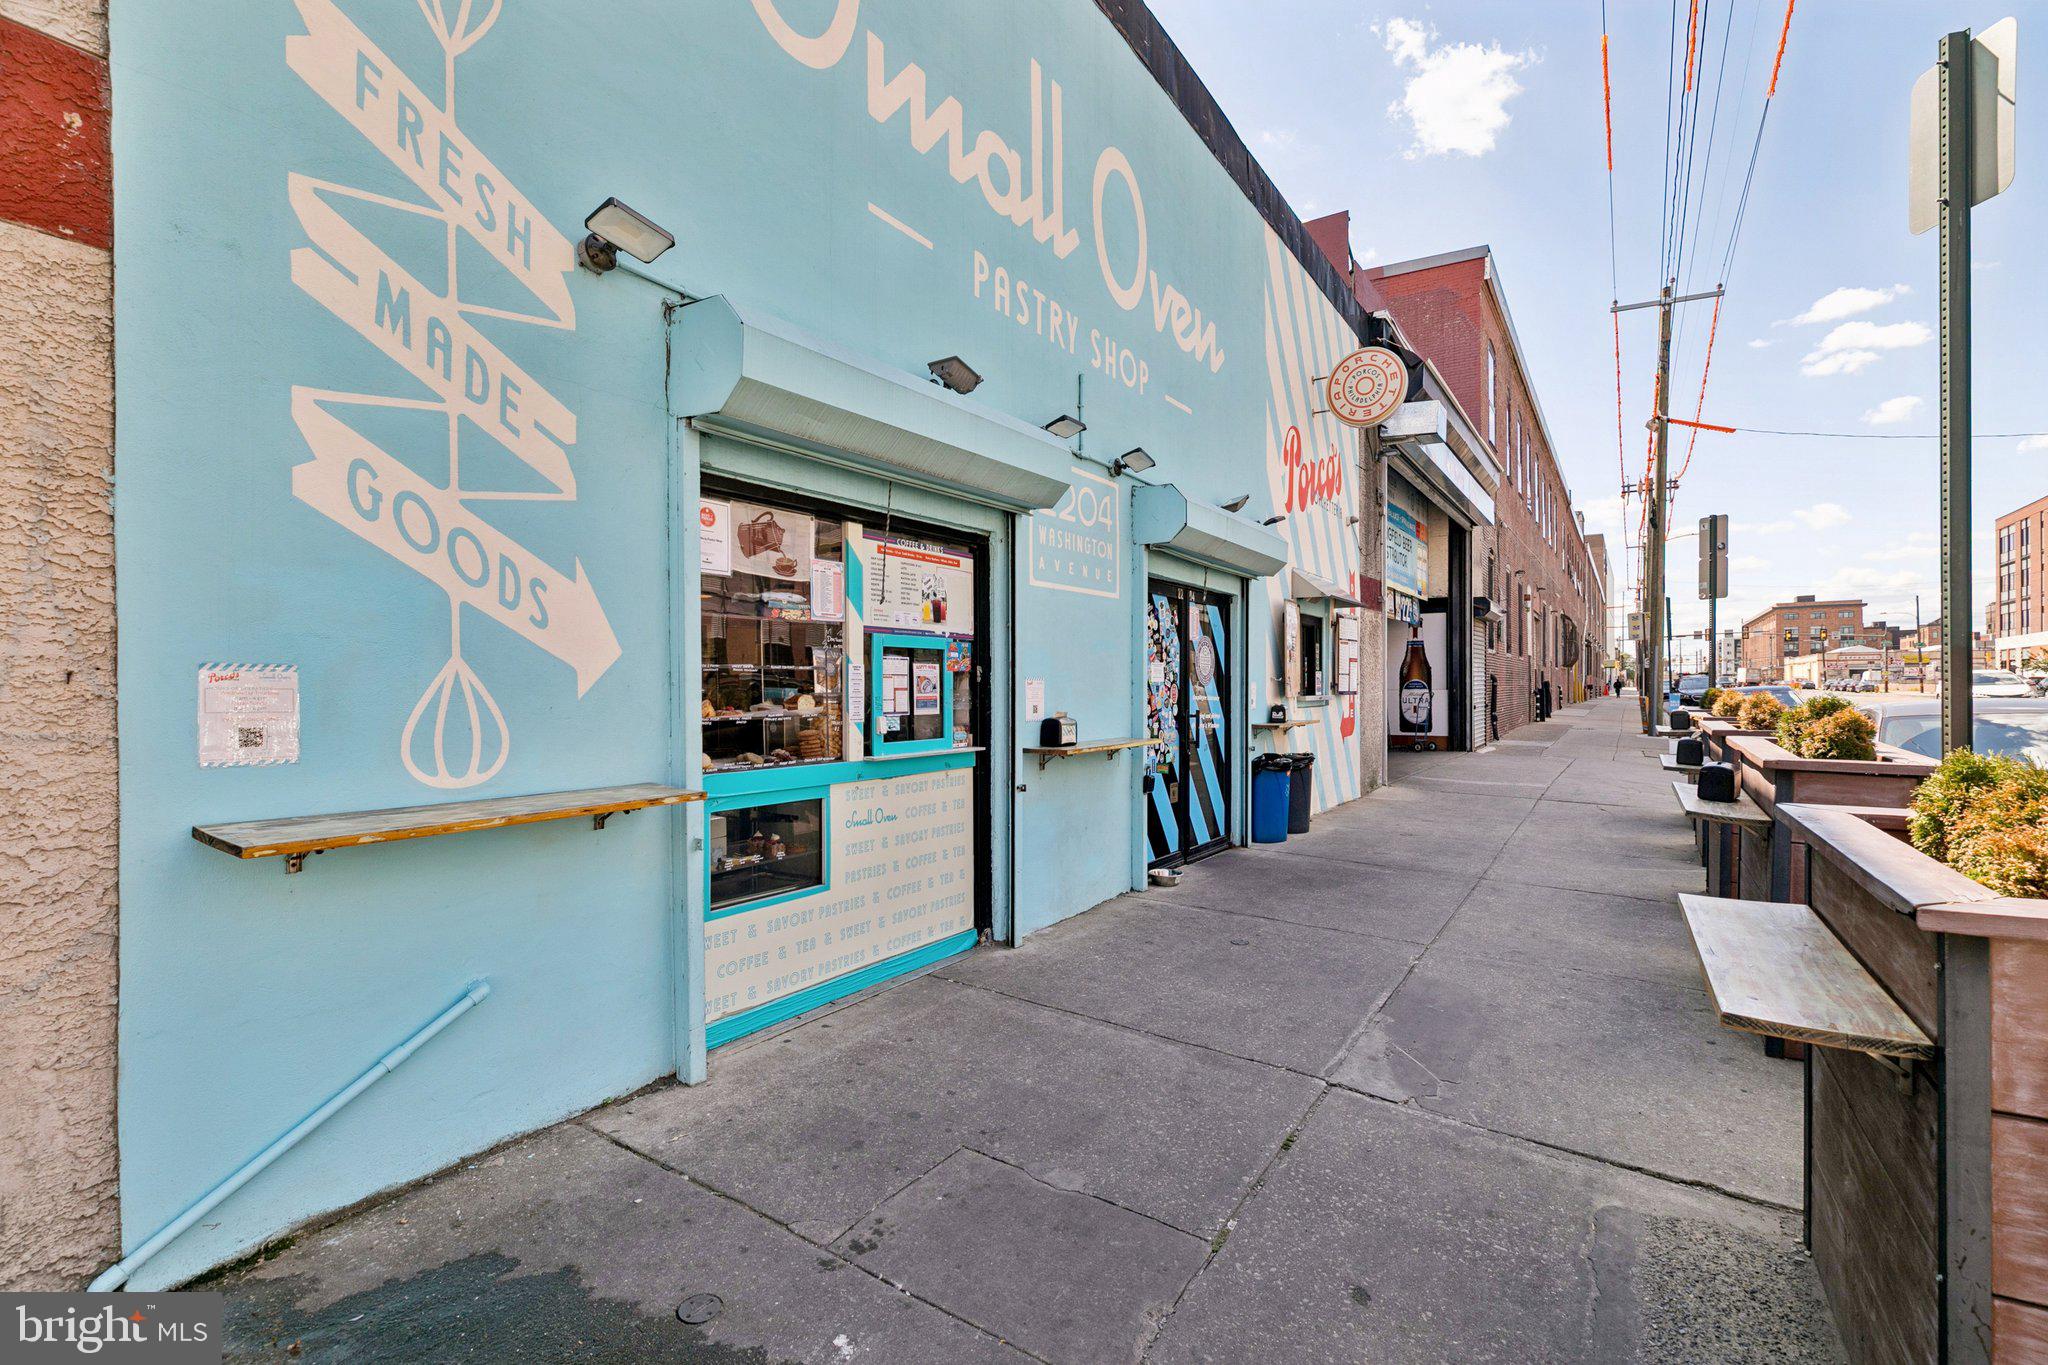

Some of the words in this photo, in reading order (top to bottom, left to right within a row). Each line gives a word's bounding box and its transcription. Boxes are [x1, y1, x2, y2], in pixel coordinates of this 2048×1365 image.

[355, 47, 532, 270] FRESH
[1092, 146, 1225, 374] Oven
[974, 250, 1081, 354] PASTRY
[1090, 328, 1150, 396] SHOP
[375, 269, 523, 440] MADE
[1039, 485, 1112, 532] 204
[347, 457, 549, 631] GOODS
[896, 538, 919, 549] COFFEE
[1039, 524, 1113, 561] WASHINGTON
[1039, 556, 1112, 582] AVENUE
[845, 787, 875, 801] SWEET
[882, 785, 889, 797] &
[895, 780, 928, 796] SAVORY
[932, 775, 966, 790] PASTRIES
[845, 808, 873, 828] Small
[875, 807, 898, 824] Oven
[905, 803, 936, 819] COFFEE
[942, 801, 948, 812] &
[953, 798, 965, 810] TEA
[845, 839, 875, 856] SWEET
[882, 836, 889, 849] &
[895, 828, 928, 846] SAVORY
[932, 822, 965, 838] PASTRIES
[845, 863, 887, 885] PASTRIES
[893, 860, 899, 872] &
[905, 852, 937, 869] COFFEE
[942, 849, 948, 860] &
[953, 845, 965, 858] TEA
[747, 924, 757, 938] &
[767, 909, 814, 934] SAVORY
[819, 895, 866, 920] PASTRIES
[872, 891, 880, 904] &
[886, 881, 922, 901] COFFEE
[927, 877, 934, 888] &
[940, 871, 954, 885] TEA
[960, 869, 965, 880] &
[716, 950, 769, 978] COFFEE
[778, 946, 787, 959] &
[796, 936, 816, 954] TEA
[824, 932, 832, 945] &
[840, 919, 872, 941] SWEET
[878, 916, 886, 928] &
[892, 903, 927, 925] SAVORY
[930, 892, 965, 913] PASTRIES
[747, 985, 757, 1000] &
[766, 966, 814, 994] SAVORY
[818, 949, 866, 976] PASTRIES
[872, 944, 880, 956] &
[886, 931, 922, 951] COFFEE
[927, 926, 934, 938] &
[940, 920, 954, 933] TEA
[960, 916, 966, 927] &
